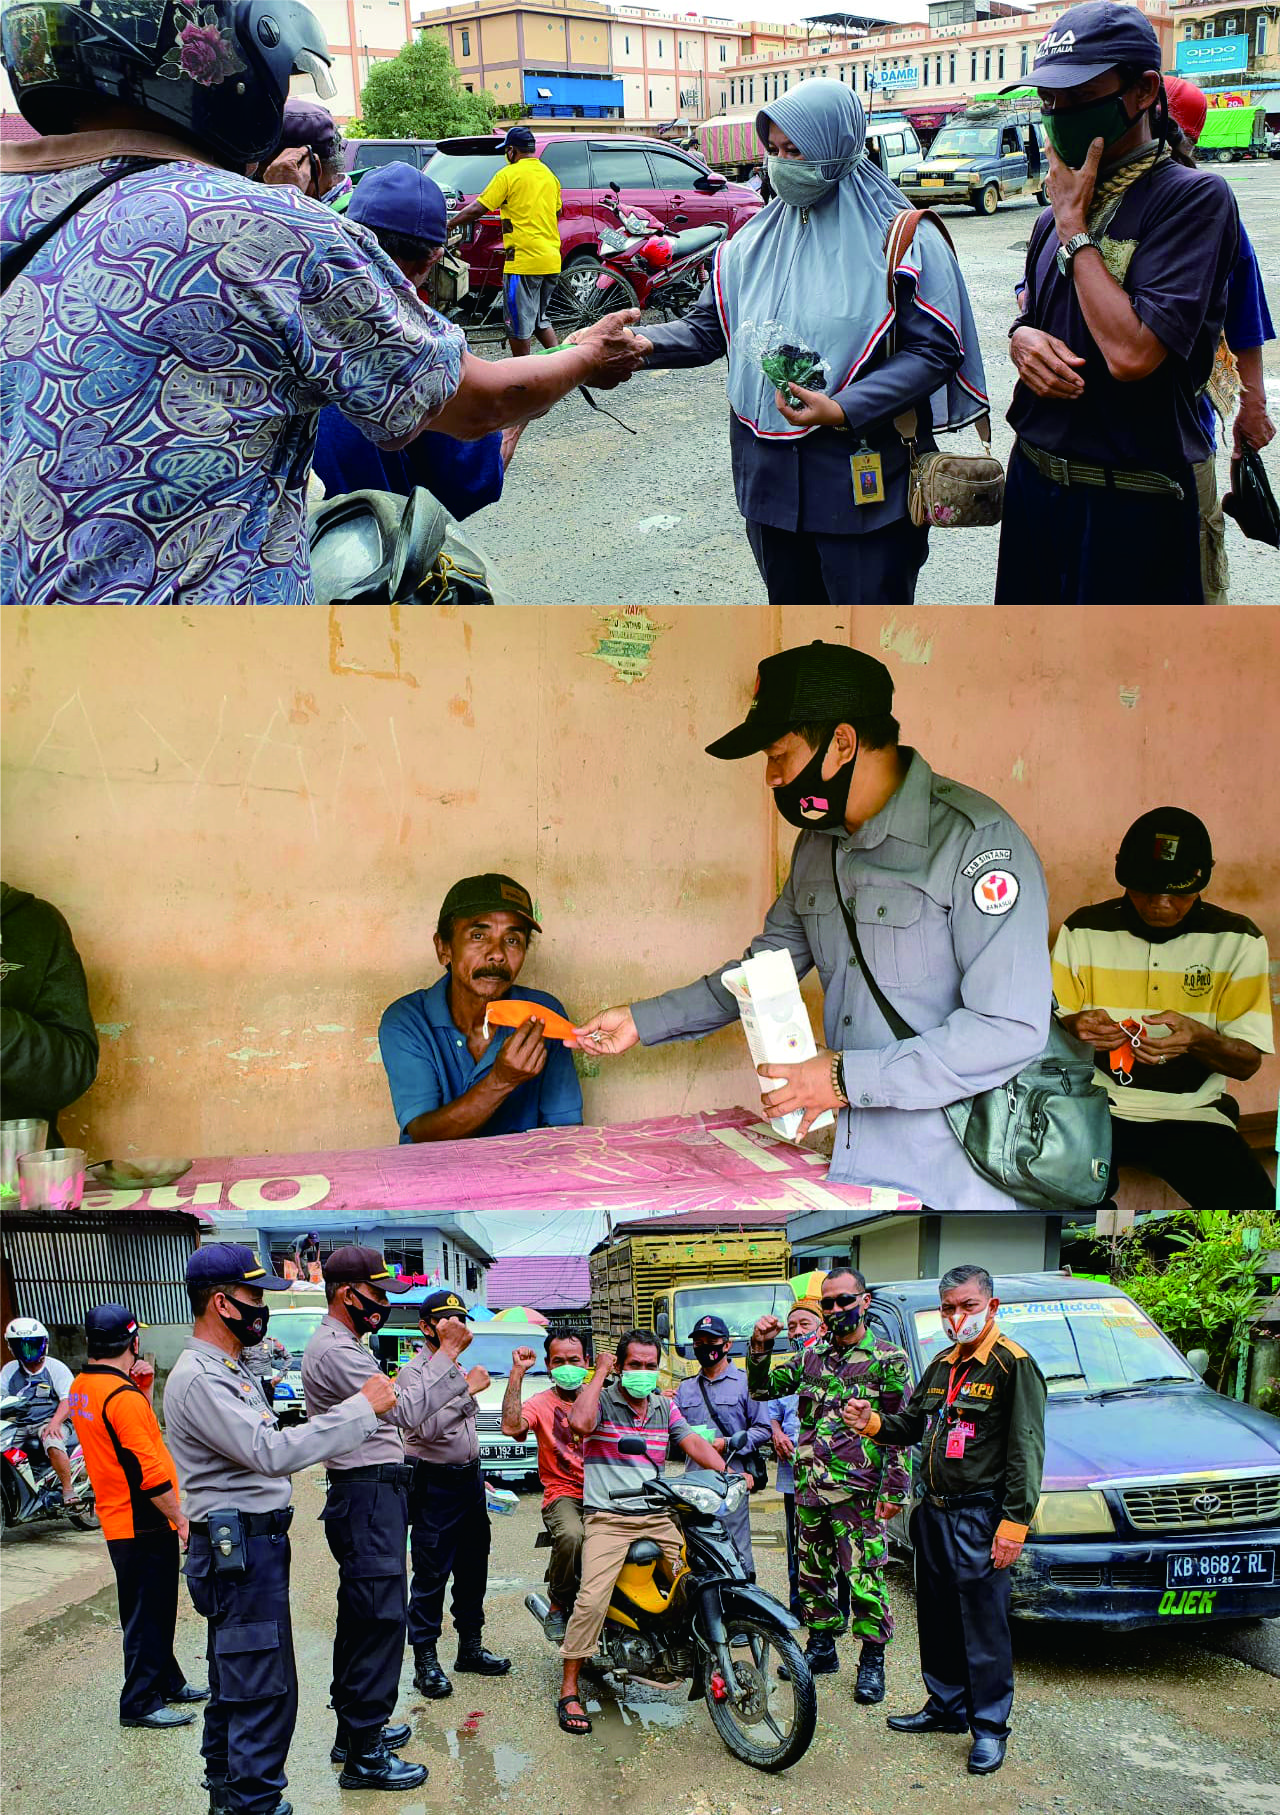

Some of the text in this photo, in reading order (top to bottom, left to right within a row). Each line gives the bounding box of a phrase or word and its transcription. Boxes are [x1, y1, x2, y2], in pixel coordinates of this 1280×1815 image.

[1186, 45, 1236, 57] oppo
[881, 68, 918, 81] DAMRI
[1196, 972, 1211, 986] POLO
[971, 1382, 995, 1397] KPU
[480, 1447, 491, 1456] KB
[514, 1446, 525, 1456] EA
[1173, 1553, 1268, 1577] KB 8682 RL
[1158, 1590, 1217, 1615] OJEK
